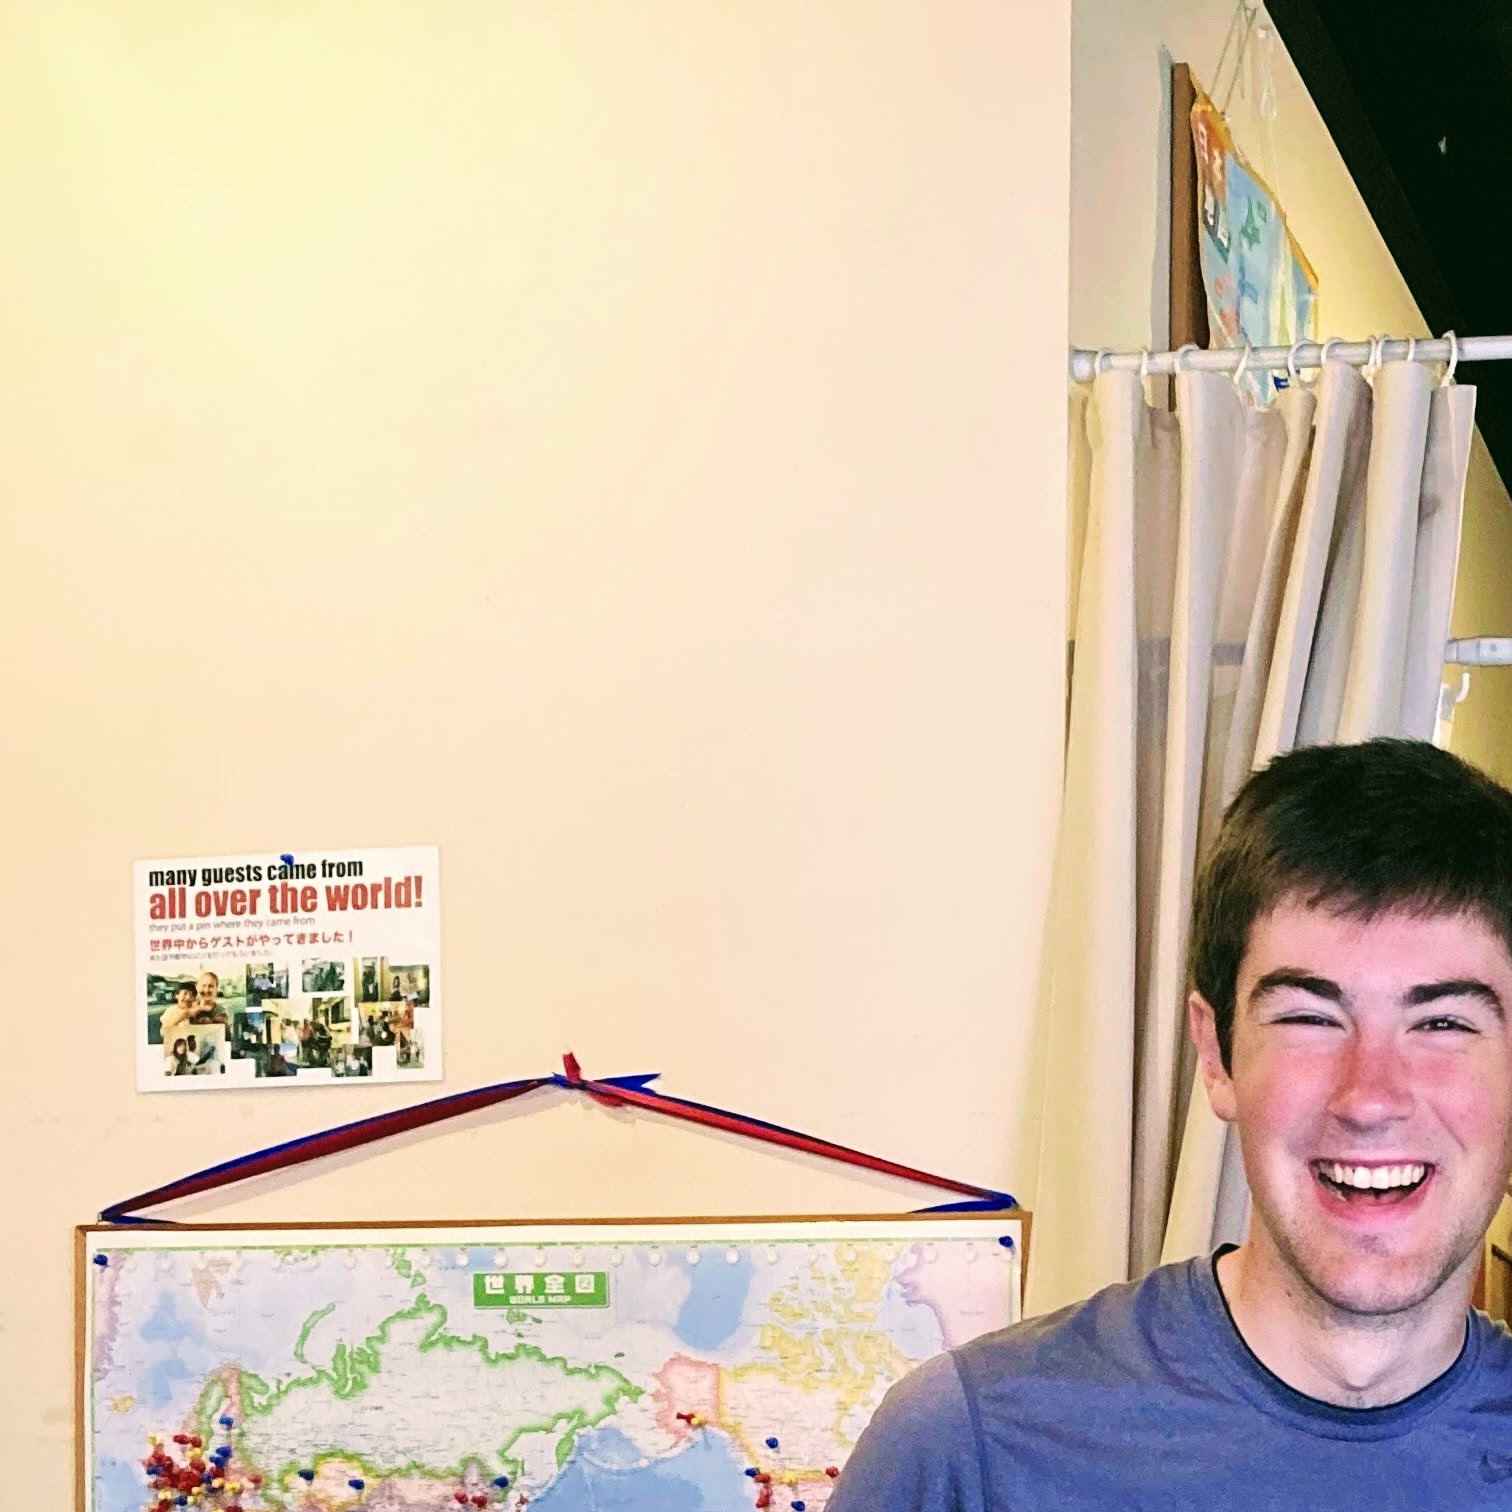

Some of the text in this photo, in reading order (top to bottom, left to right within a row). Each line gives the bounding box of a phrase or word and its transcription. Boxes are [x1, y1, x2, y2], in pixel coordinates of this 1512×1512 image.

[149, 859, 363, 887] many guests came from
[149, 875, 423, 919] all over the world!
[149, 923, 168, 932] they
[171, 923, 186, 933] put
[213, 920, 241, 929] where
[244, 919, 263, 929] they
[266, 918, 291, 927] came
[293, 916, 316, 925] from
